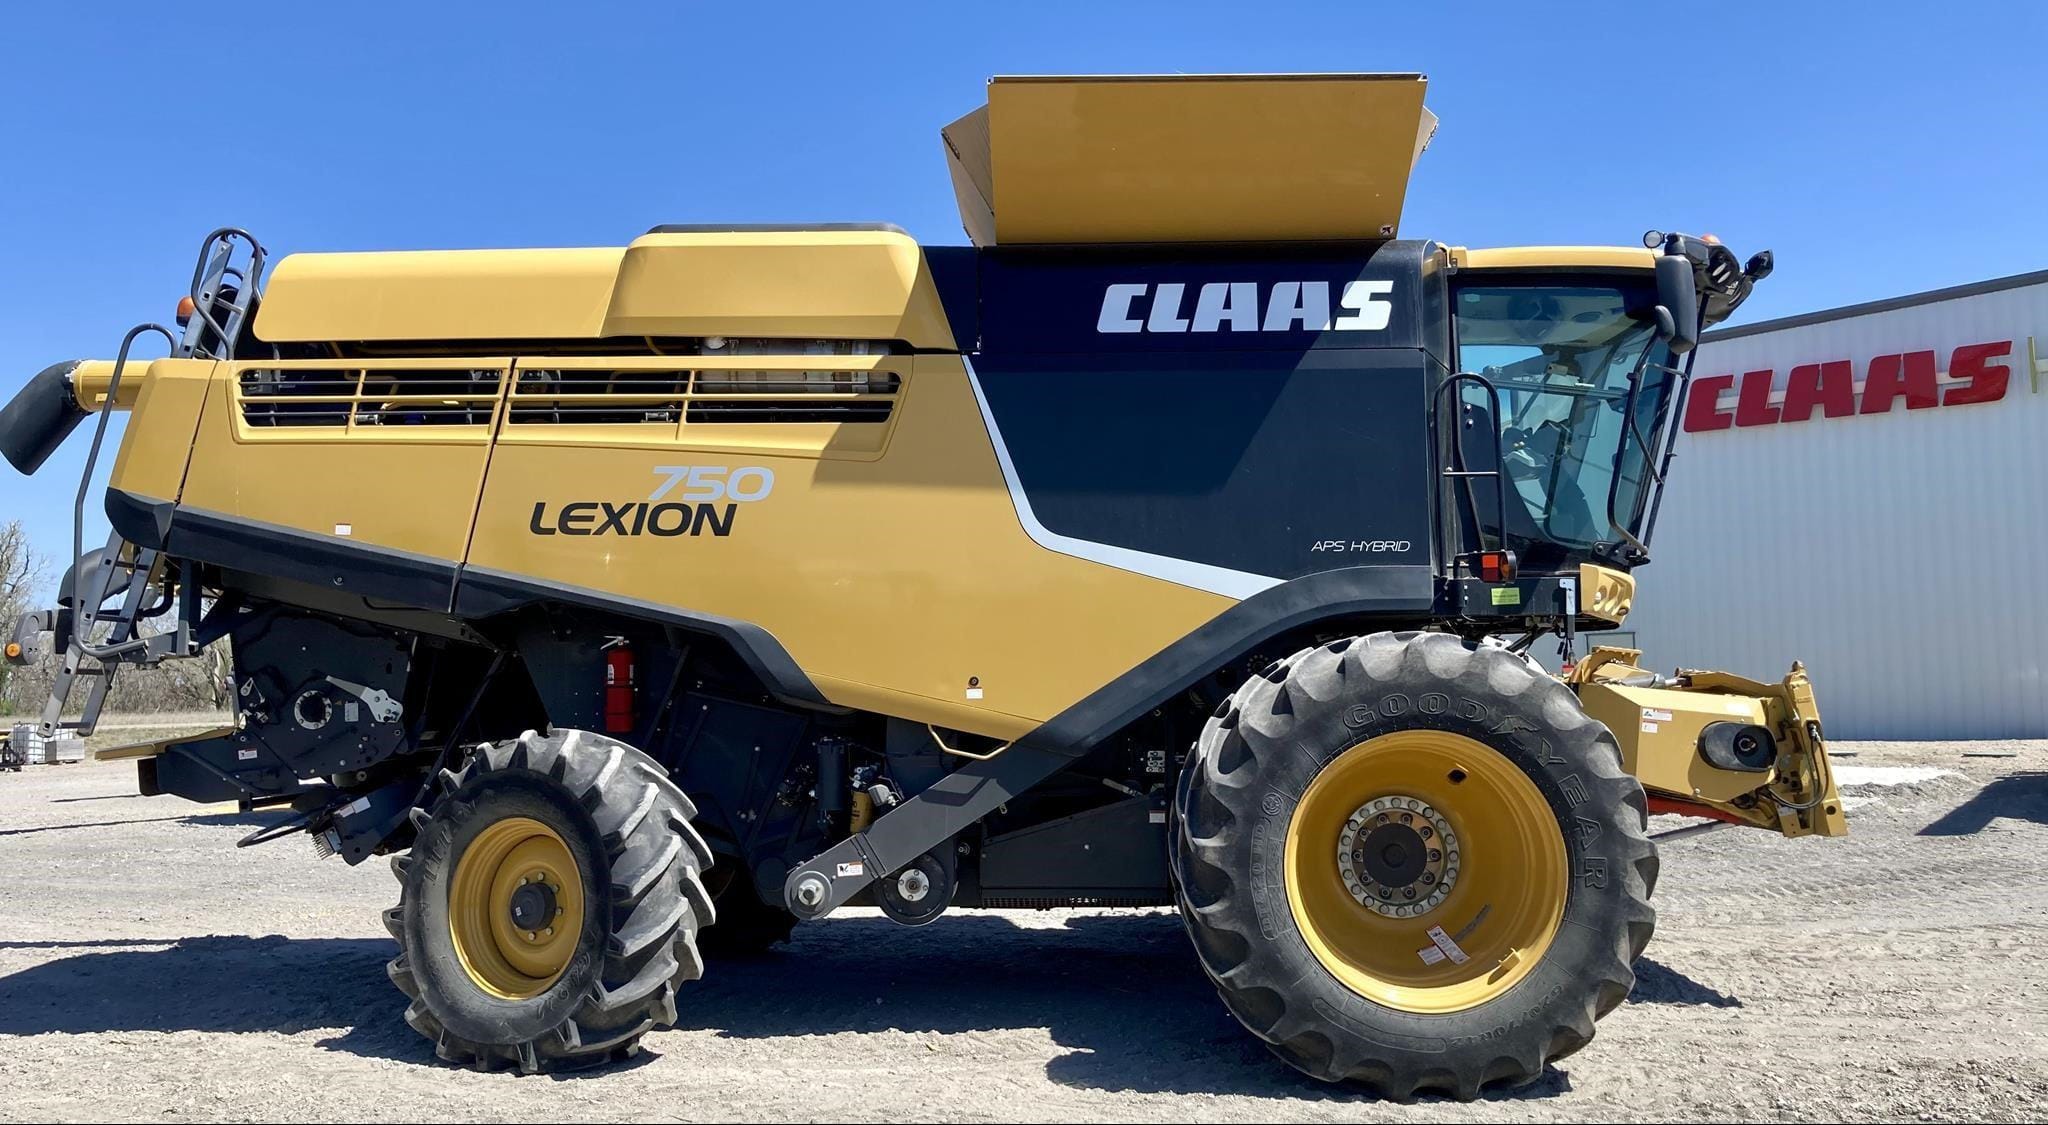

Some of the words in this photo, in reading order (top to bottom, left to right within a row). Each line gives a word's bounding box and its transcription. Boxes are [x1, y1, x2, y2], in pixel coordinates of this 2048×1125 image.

[1096, 280, 1394, 333] CLAAS
[1683, 340, 2013, 433] CLAAS
[647, 465, 775, 503] 750
[529, 502, 738, 537] LEXION
[1310, 540, 1346, 552] APS
[1350, 540, 1411, 552] HYBRID
